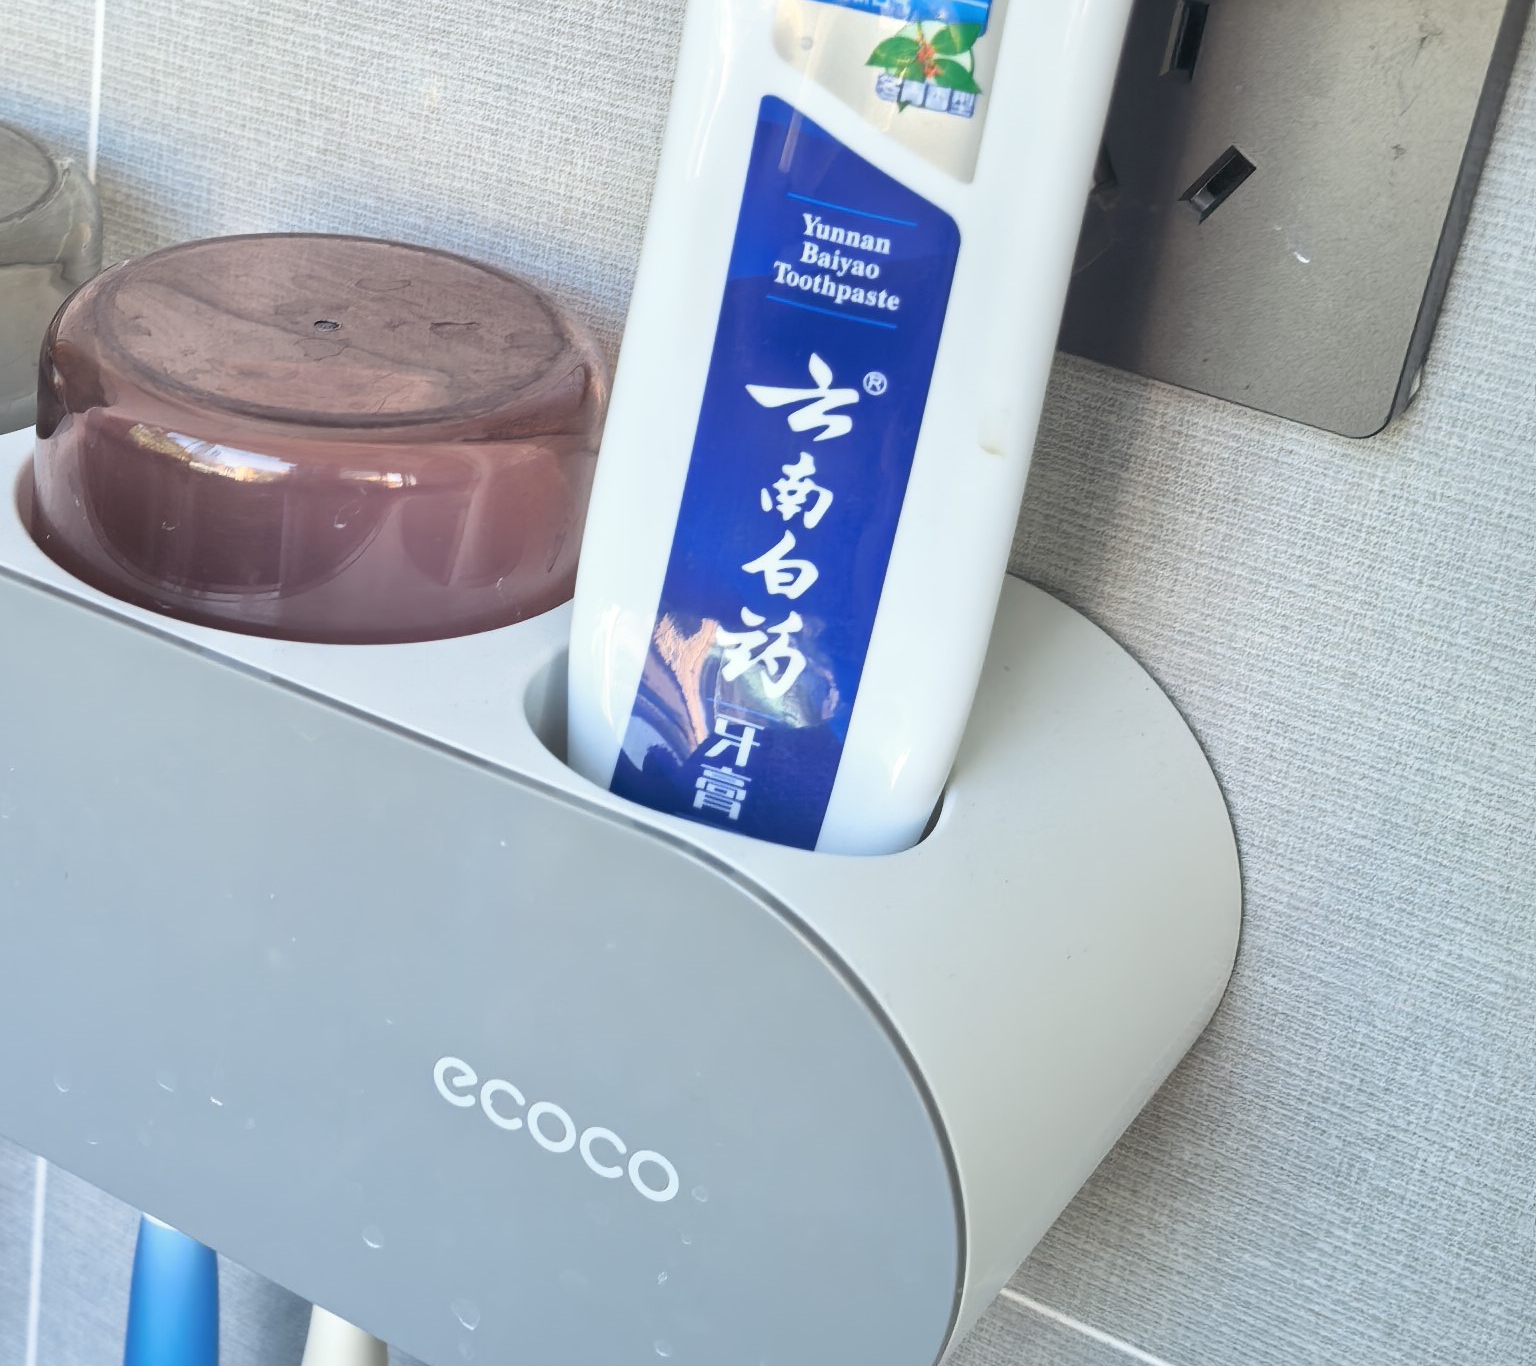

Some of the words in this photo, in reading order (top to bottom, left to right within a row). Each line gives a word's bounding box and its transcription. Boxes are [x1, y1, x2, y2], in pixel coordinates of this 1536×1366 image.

[799, 241, 880, 282] Baiyao
[800, 212, 892, 256] Yunnan
[773, 260, 901, 314] Toothpaste
[715, 351, 860, 699] 云南白药
[693, 714, 765, 822] 牙膏
[433, 1056, 680, 1202] ecoco
